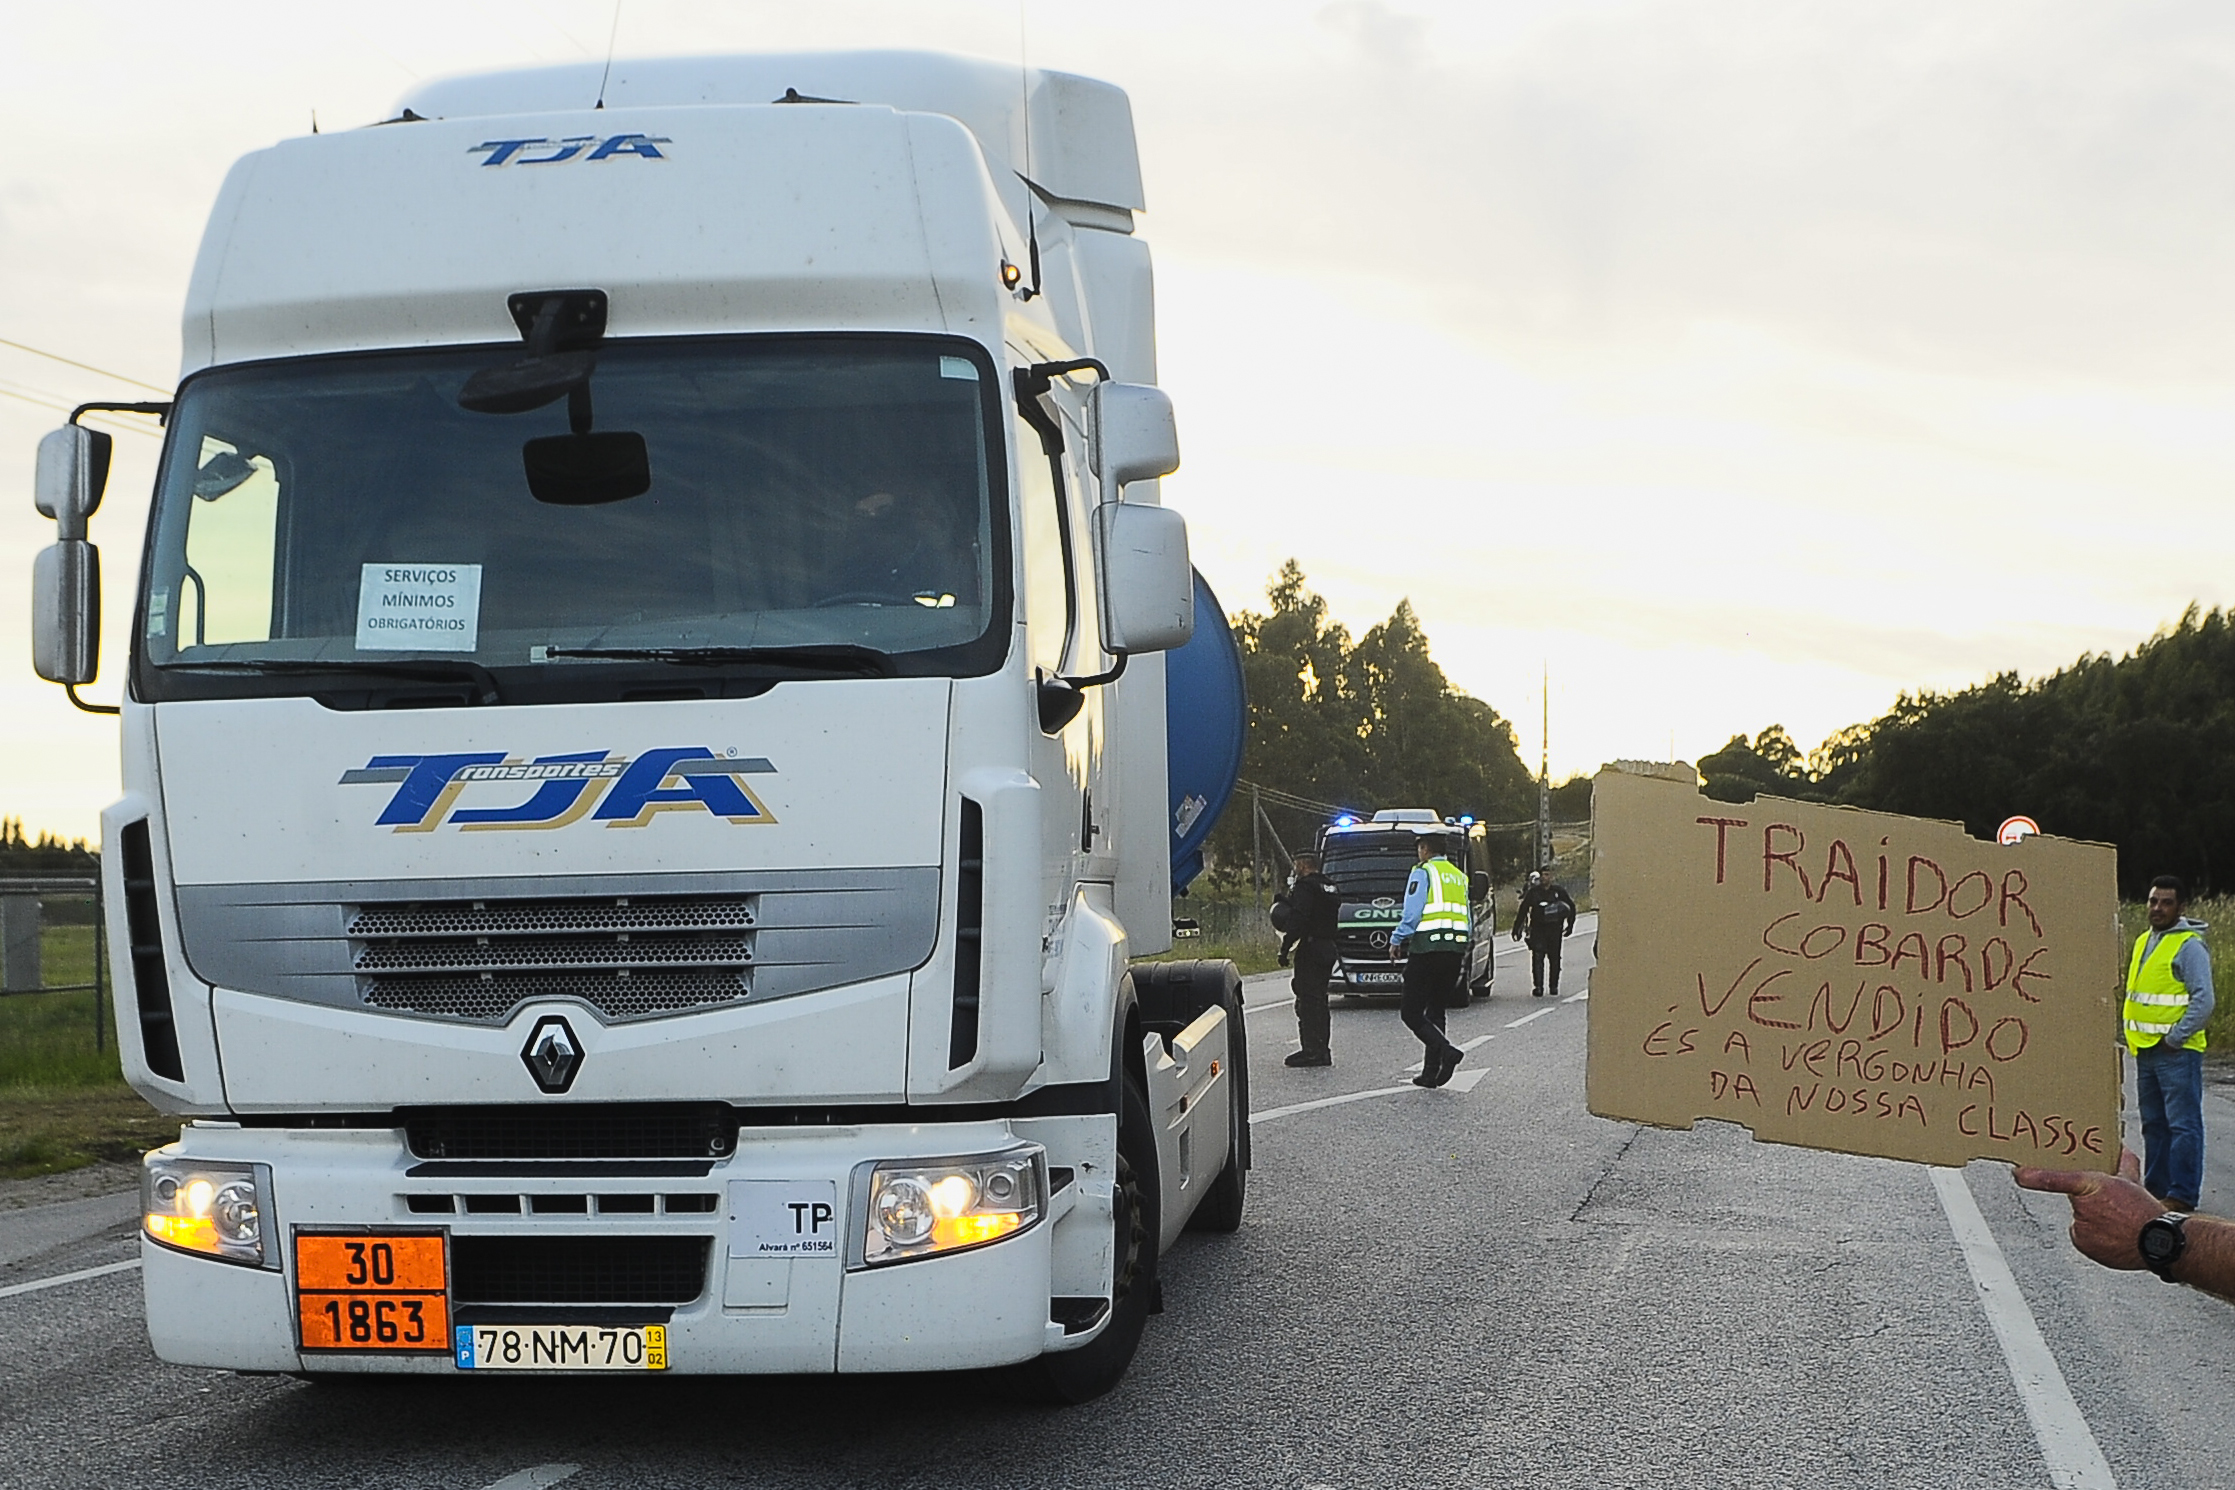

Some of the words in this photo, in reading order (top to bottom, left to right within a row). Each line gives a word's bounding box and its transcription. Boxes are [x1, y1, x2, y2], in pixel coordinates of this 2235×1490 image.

[467, 133, 672, 167] TJA
[384, 569, 457, 585] SERVIÇOS
[382, 591, 455, 608] MÍNIMOS
[367, 616, 466, 631] OBRIGATÓRIOS
[338, 747, 778, 833] TJA
[1763, 912, 2052, 1003] COBARDE
[1643, 1004, 1699, 1056] ÉS
[1724, 1031, 1749, 1064] A
[1711, 1071, 1761, 1108] DA
[1786, 1083, 1927, 1127] NOSSA
[1958, 1104, 2103, 1155] CLASSE
[787, 1203, 832, 1234] TP
[759, 1243, 788, 1251] Alvará
[345, 1242, 394, 1285] 30
[325, 1300, 424, 1343] 1863
[647, 1331, 662, 1342] 13
[461, 1351, 469, 1360] P
[647, 1353, 663, 1365] 02
